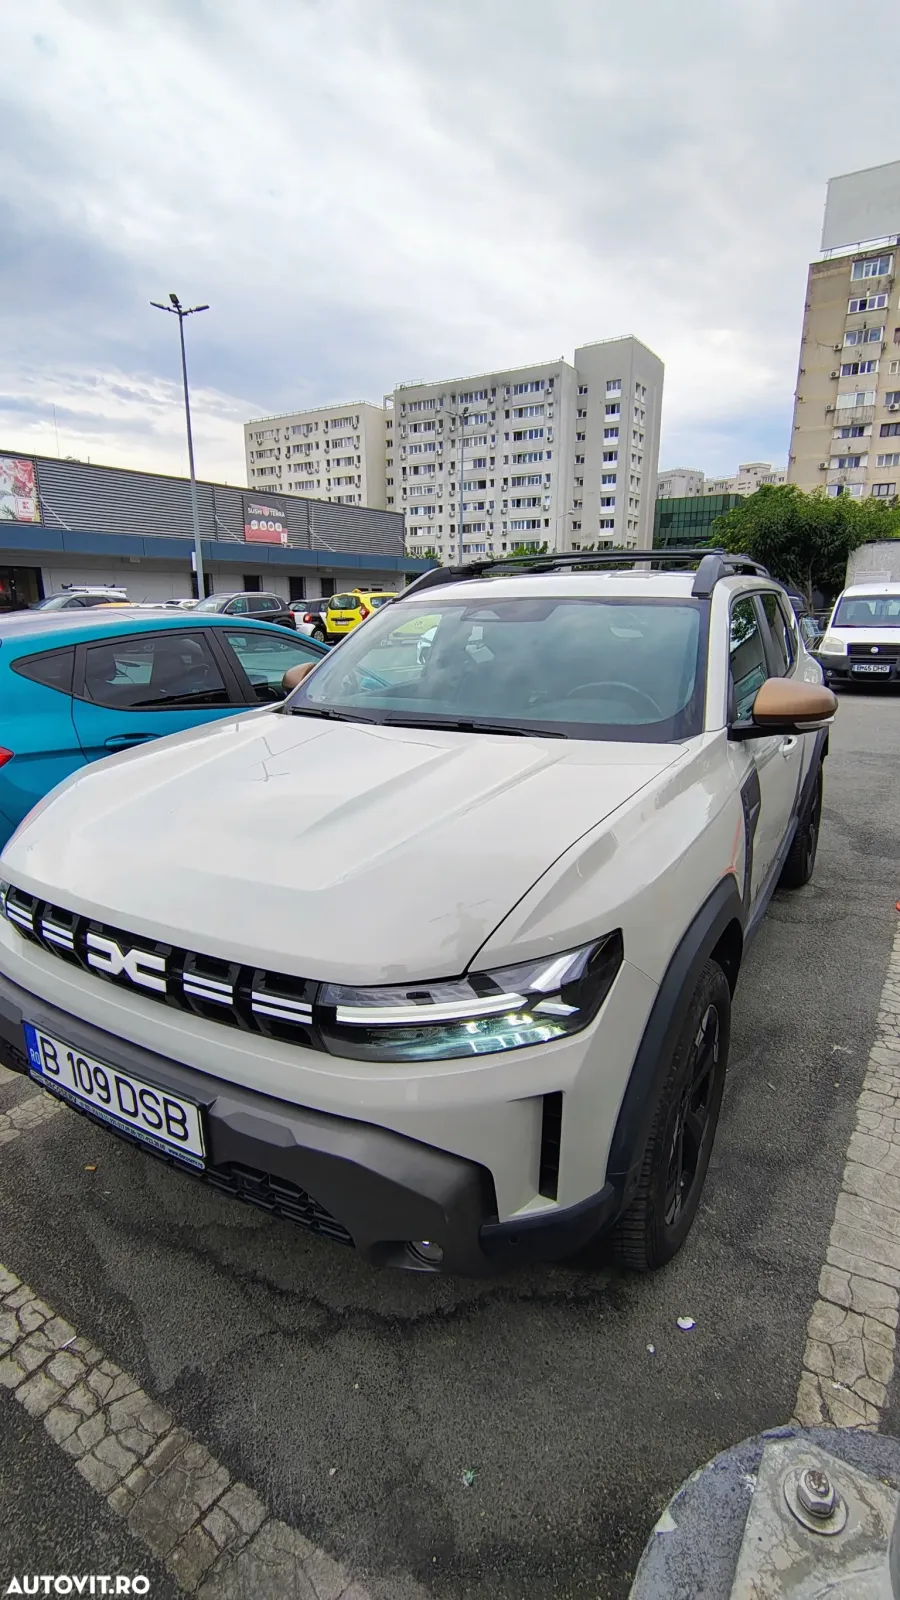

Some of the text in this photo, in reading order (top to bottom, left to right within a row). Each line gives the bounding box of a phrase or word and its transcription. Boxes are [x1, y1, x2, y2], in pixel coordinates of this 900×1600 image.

[30, 1048, 41, 1065] RO
[39, 1036, 60, 1076] B
[67, 1051, 112, 1105] 109
[114, 1075, 189, 1142] DSB
